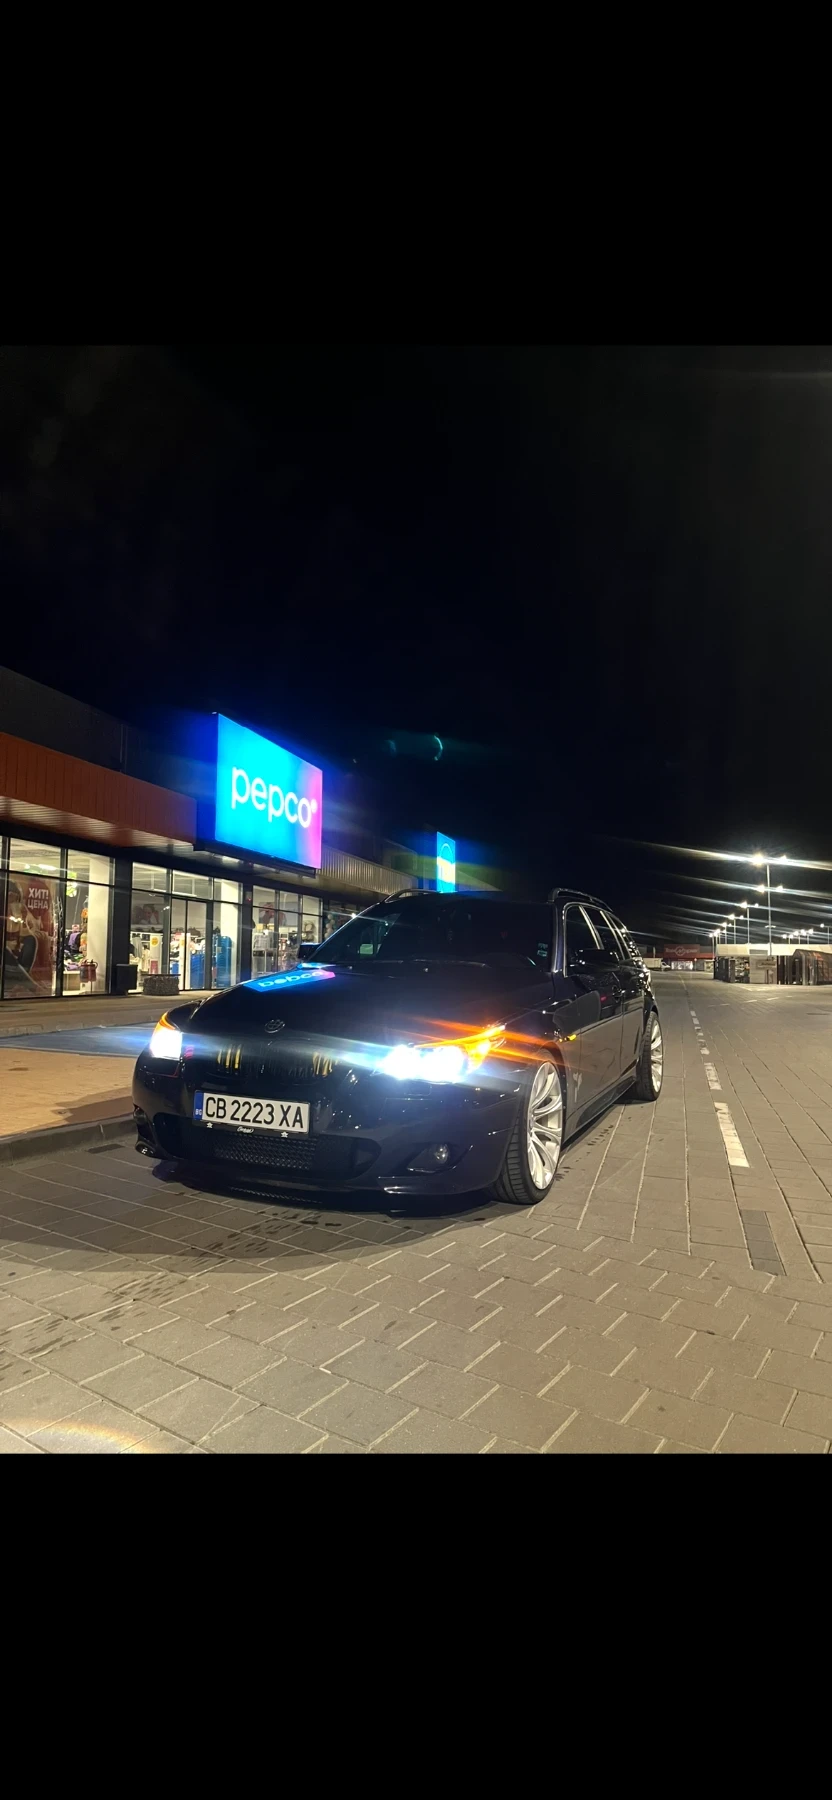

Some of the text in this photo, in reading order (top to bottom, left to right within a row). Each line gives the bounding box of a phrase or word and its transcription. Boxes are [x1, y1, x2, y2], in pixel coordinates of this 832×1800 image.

[231, 766, 312, 828] pepco
[28, 887, 49, 899] ХИТ!
[27, 899, 49, 910] ЦЕНА
[195, 1108, 203, 1116] BG
[205, 1096, 304, 1129] CB 2223 XA
